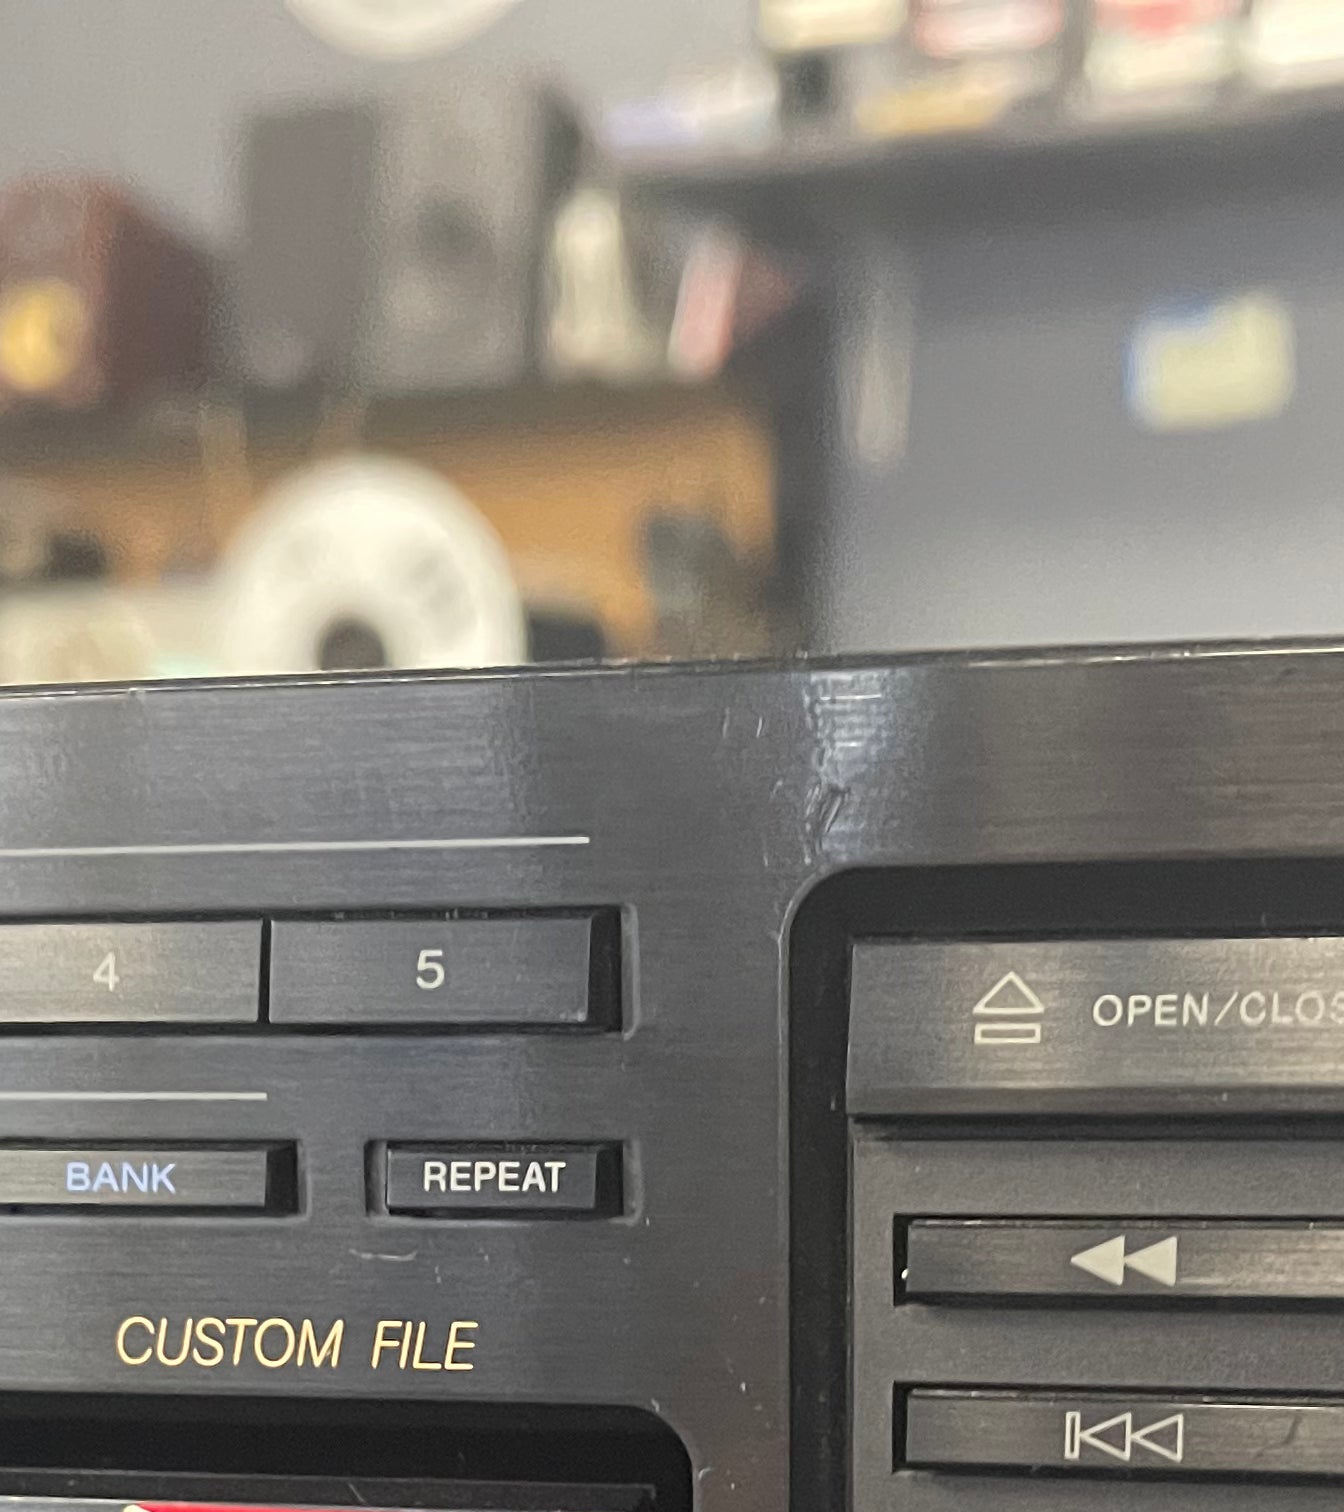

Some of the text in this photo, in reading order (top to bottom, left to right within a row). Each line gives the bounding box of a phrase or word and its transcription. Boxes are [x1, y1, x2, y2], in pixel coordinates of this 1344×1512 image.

[92, 953, 120, 992] 4
[416, 950, 446, 990] 5
[66, 1162, 177, 1194] BANK
[423, 1161, 566, 1193] REPEAT
[116, 1316, 479, 1371] CUSTOM FILE
